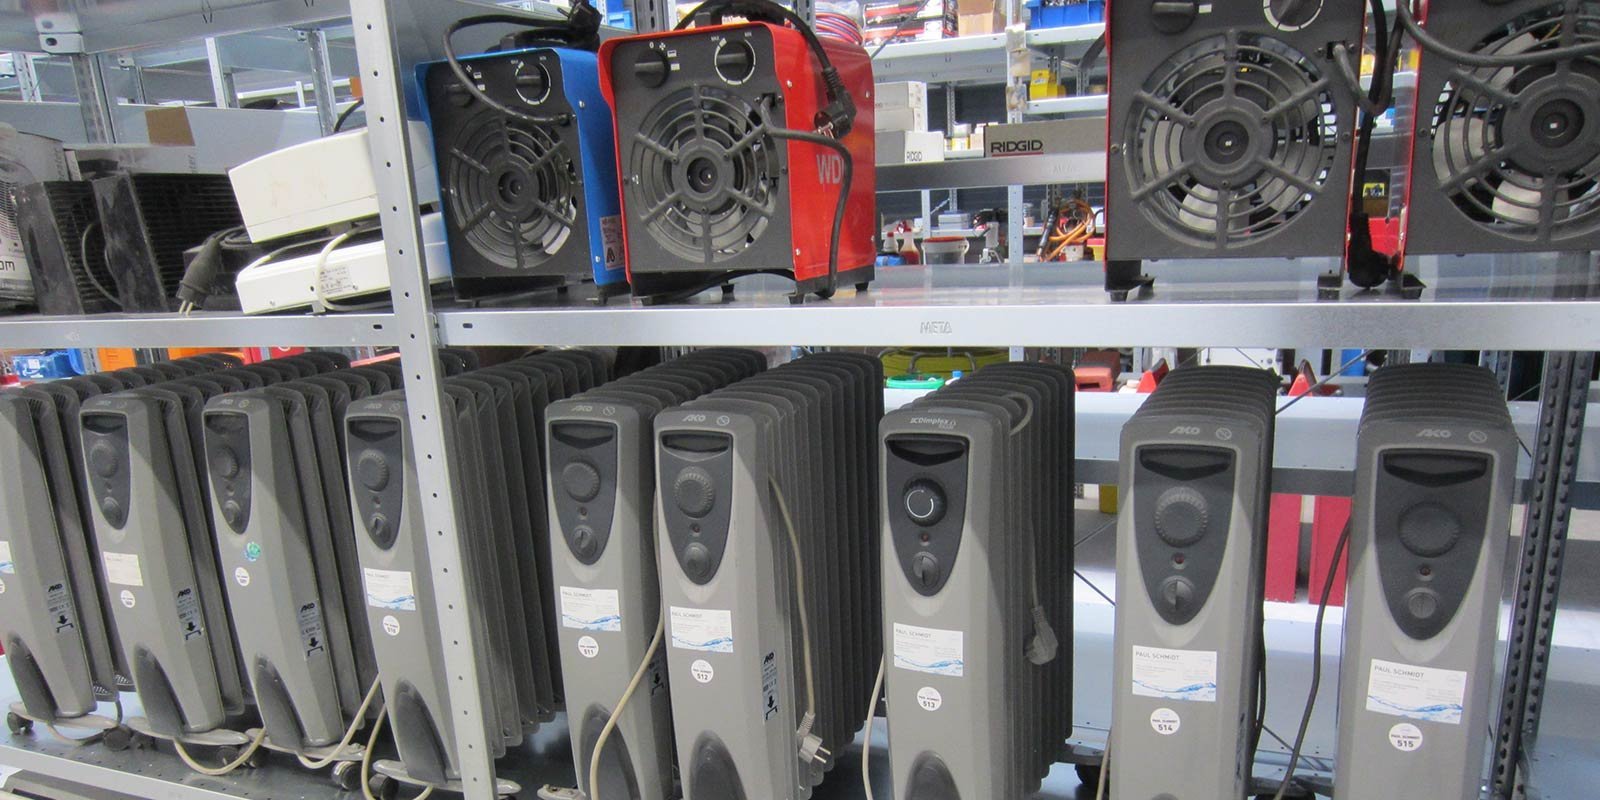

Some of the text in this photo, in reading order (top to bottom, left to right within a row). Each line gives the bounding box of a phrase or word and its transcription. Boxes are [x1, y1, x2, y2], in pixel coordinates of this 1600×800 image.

[991, 140, 1043, 153] RIDGID
[920, 321, 952, 334] META
[1169, 426, 1200, 435] AKO
[1416, 429, 1452, 438] AKO
[1152, 653, 1180, 661] SCHMIDT
[1374, 665, 1424, 678] PAUL SCHMIDT
[922, 701, 935, 709] 513
[1158, 724, 1173, 732] 514
[1397, 740, 1414, 748] 515
